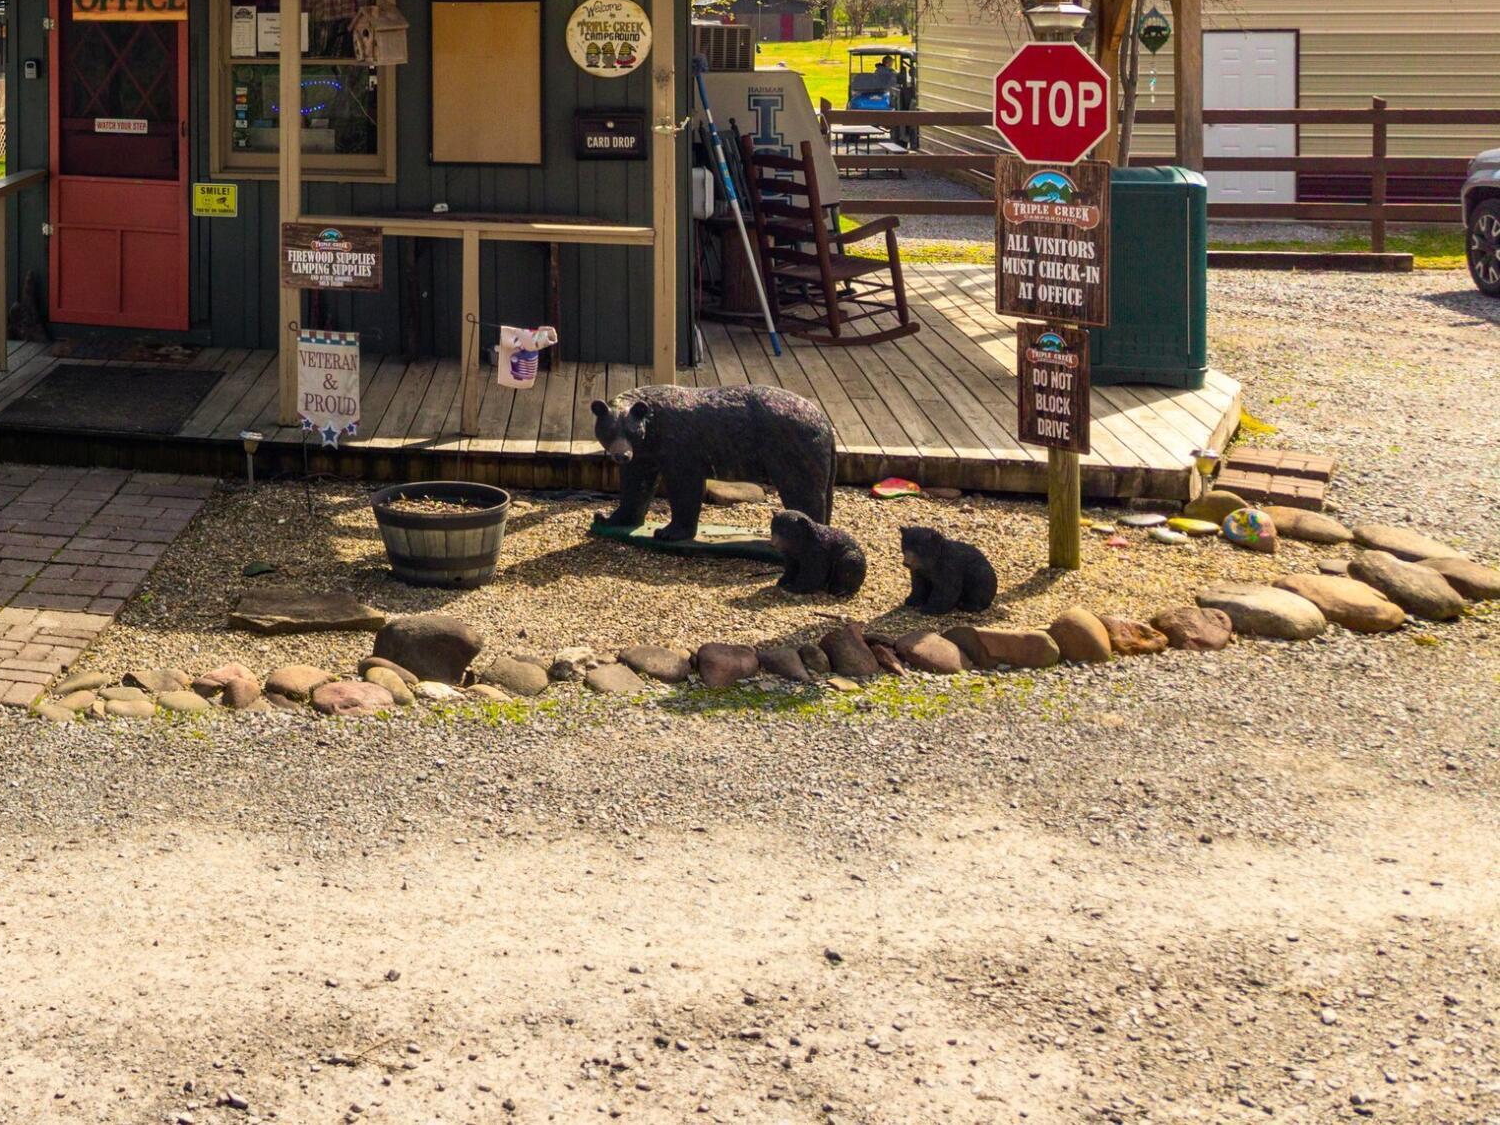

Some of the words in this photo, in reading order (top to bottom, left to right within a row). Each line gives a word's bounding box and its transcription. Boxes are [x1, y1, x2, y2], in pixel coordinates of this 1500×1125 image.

[583, 0, 622, 17] Welcome
[584, 32, 640, 42] CAMPGROUND
[1000, 79, 1103, 127] STOP
[97, 121, 116, 130] WATCH
[117, 122, 132, 131] YOUR
[132, 122, 147, 131] STEP
[587, 136, 610, 148] CARD
[612, 136, 636, 148] DROP
[200, 186, 230, 196] SMILE!
[1013, 202, 1049, 216] TRIPLE
[1054, 205, 1090, 222] CREEK
[1007, 233, 1031, 253] ALL
[1033, 235, 1096, 260] VISITORS
[288, 250, 334, 263] FIREWOOD
[336, 253, 376, 266] SUPPLIES
[292, 262, 330, 275] CAMPING
[332, 264, 372, 277] SUPPLIES
[1002, 256, 1036, 277] MUST
[1039, 260, 1101, 285] CHECK-IN
[1018, 281, 1035, 300] AT
[1037, 283, 1084, 307] OFFICE
[300, 350, 358, 372] VETERAN
[1032, 350, 1052, 359] TRIPLE
[322, 373, 339, 391] &
[1033, 368, 1048, 388] DO
[1050, 370, 1073, 391] NOT
[304, 392, 357, 416] PROUD
[1035, 393, 1071, 416] BLOCK
[1037, 417, 1070, 440] DRIVE
